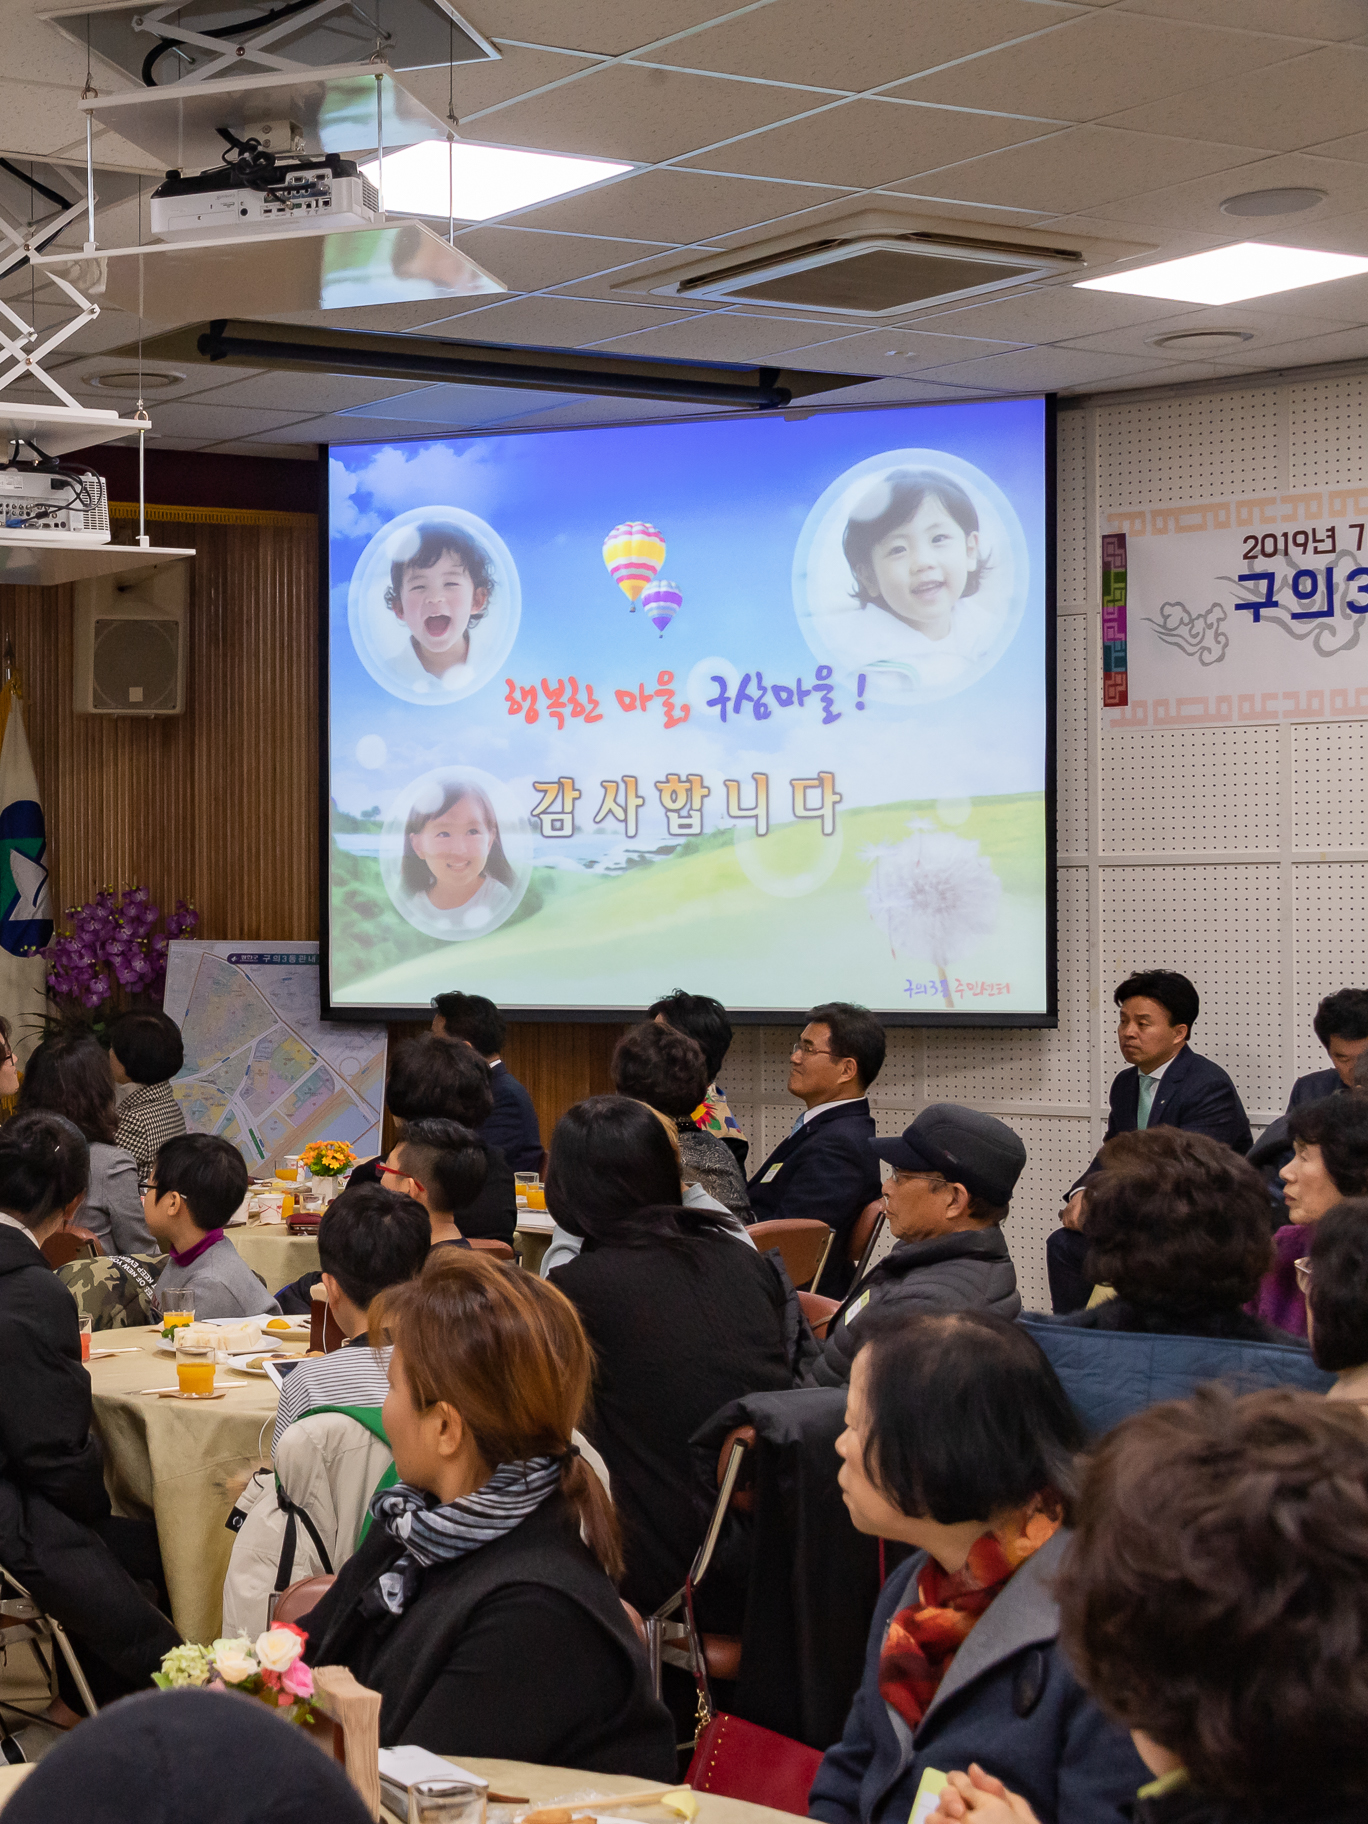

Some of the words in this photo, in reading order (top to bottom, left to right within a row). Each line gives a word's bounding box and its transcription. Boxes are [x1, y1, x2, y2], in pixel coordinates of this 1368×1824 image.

[1242, 525, 1337, 560] 2019년
[504, 675, 604, 731] 행복한
[530, 770, 844, 839] 감사합니다
[121, 1263, 138, 1278] NEW
[136, 1267, 155, 1284] KEEP
